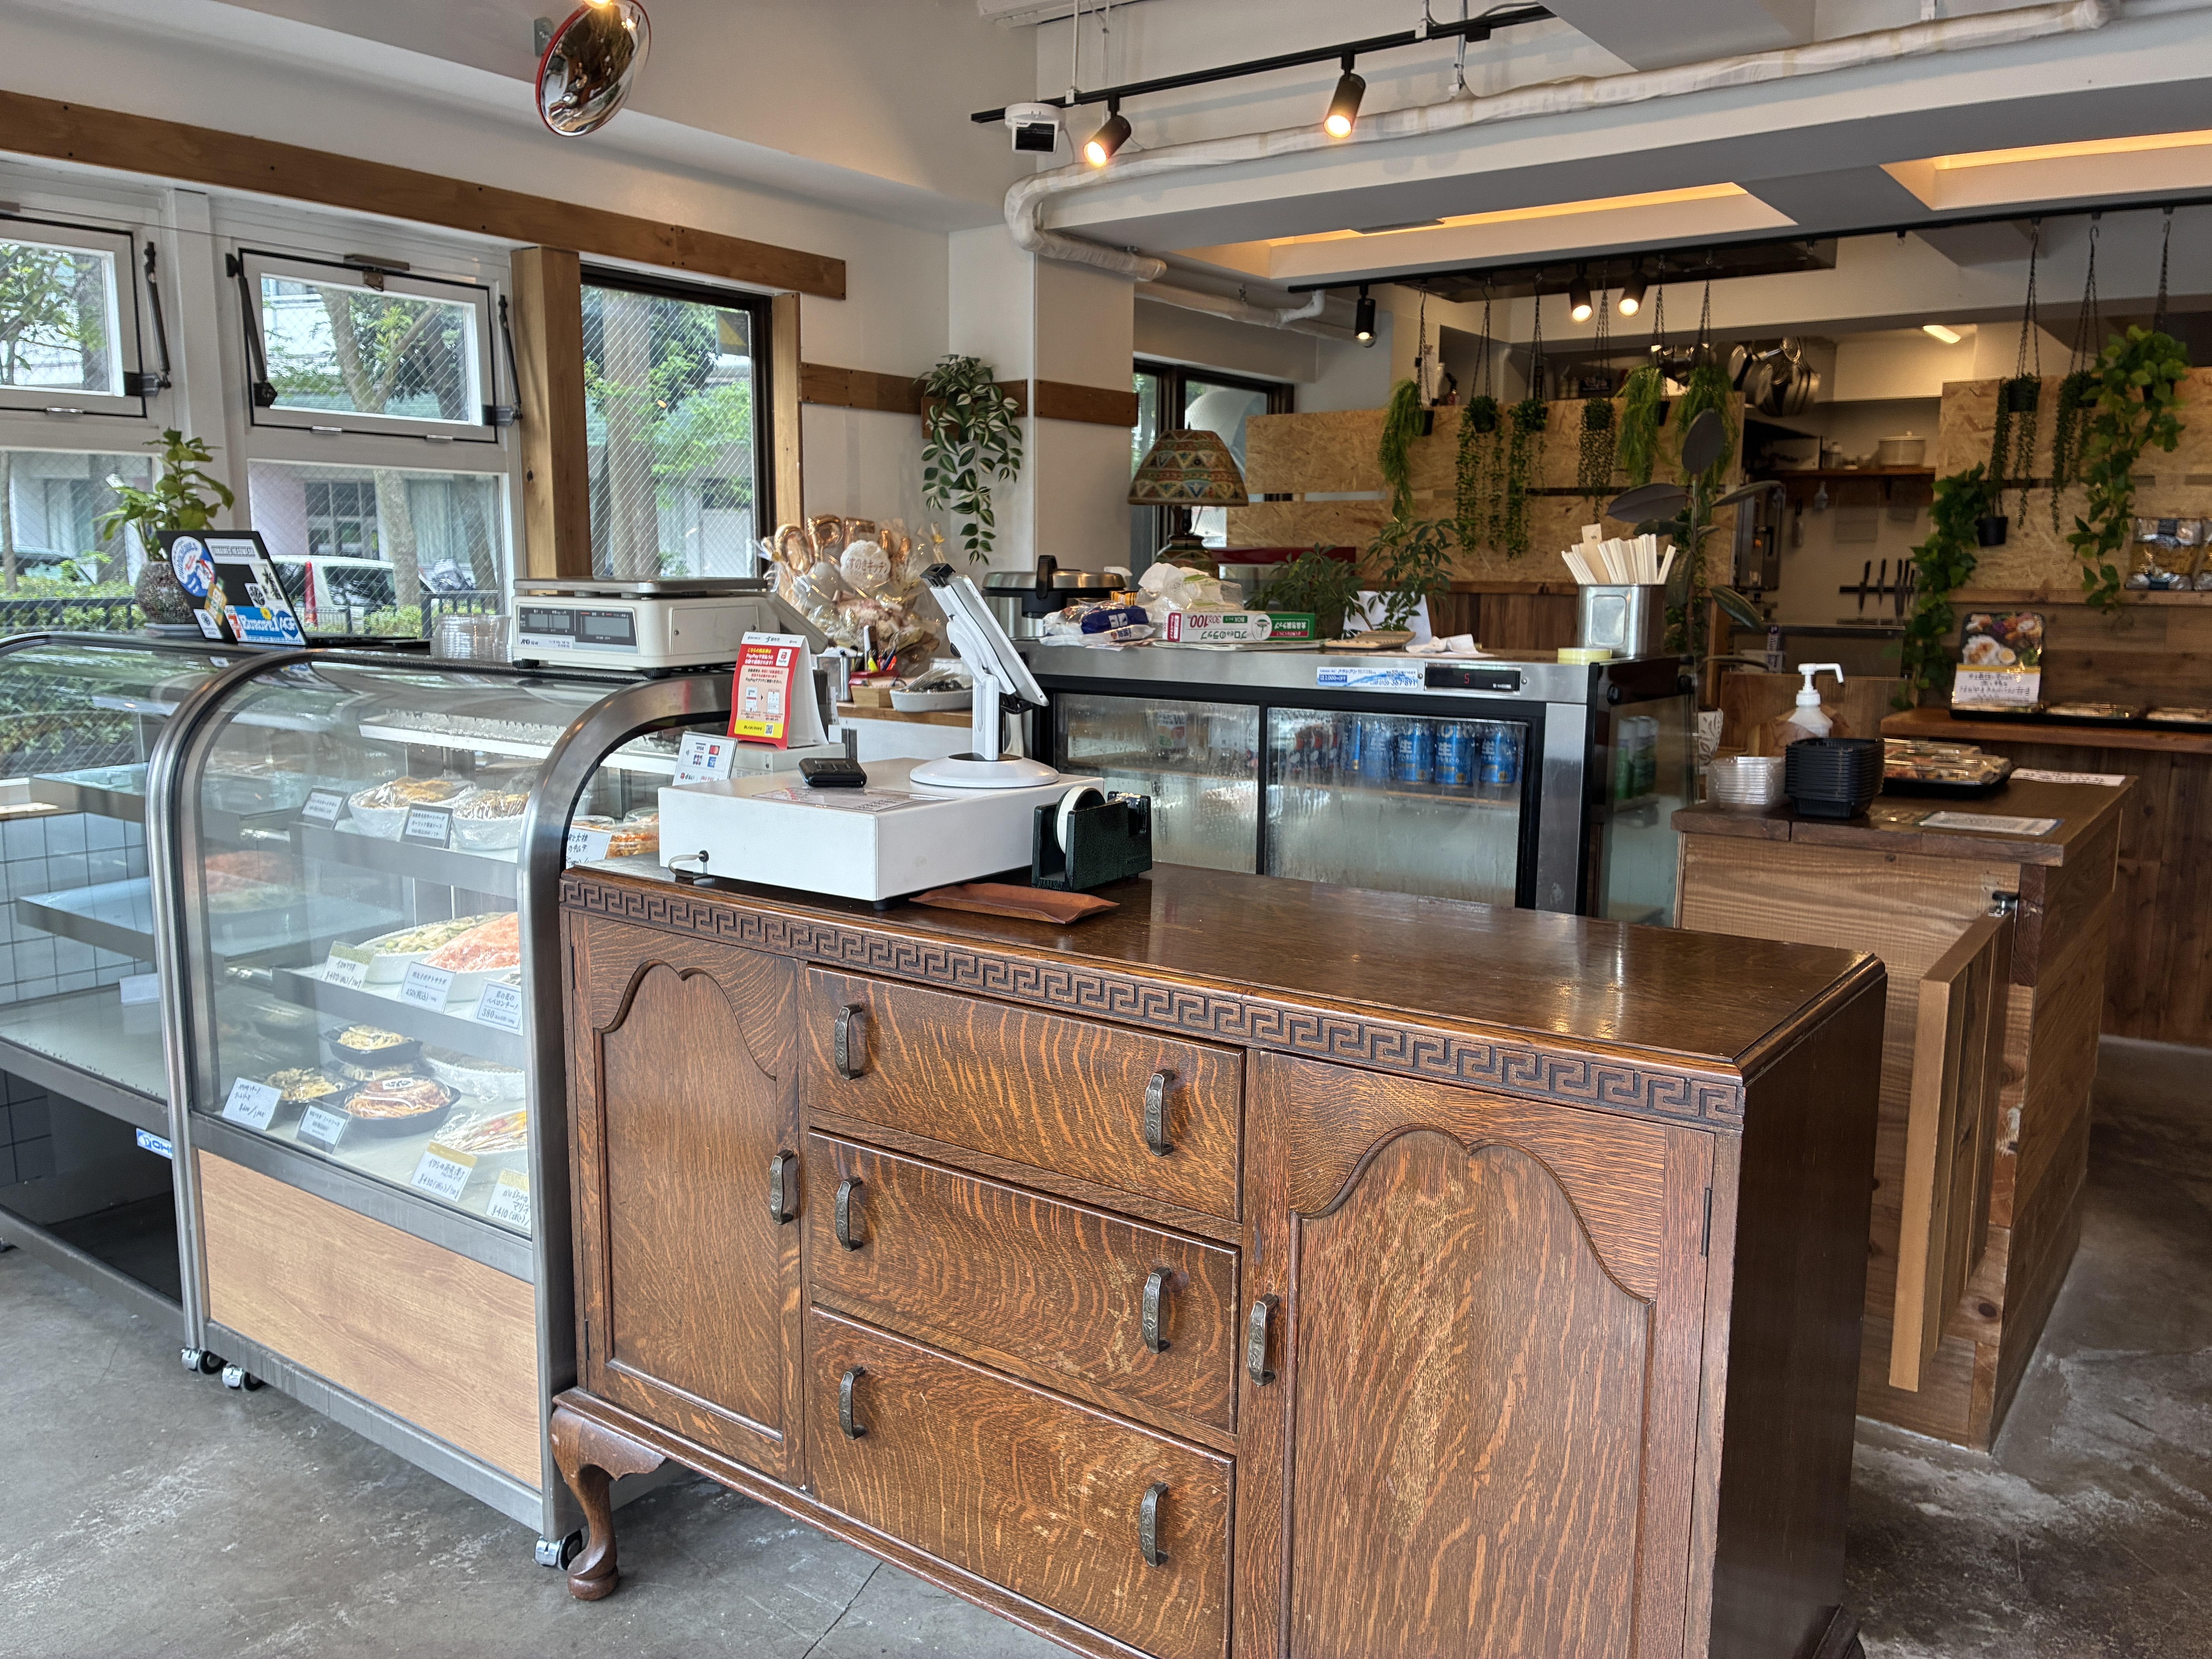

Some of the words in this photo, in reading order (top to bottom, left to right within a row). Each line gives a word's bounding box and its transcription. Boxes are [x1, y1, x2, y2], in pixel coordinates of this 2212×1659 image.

[1464, 673, 1470, 684] 5
[1400, 739, 1412, 753] 生
[1438, 742, 1452, 756] 生
[1482, 740, 1494, 755] 生
[487, 998, 519, 1010] ペペロンチーノ
